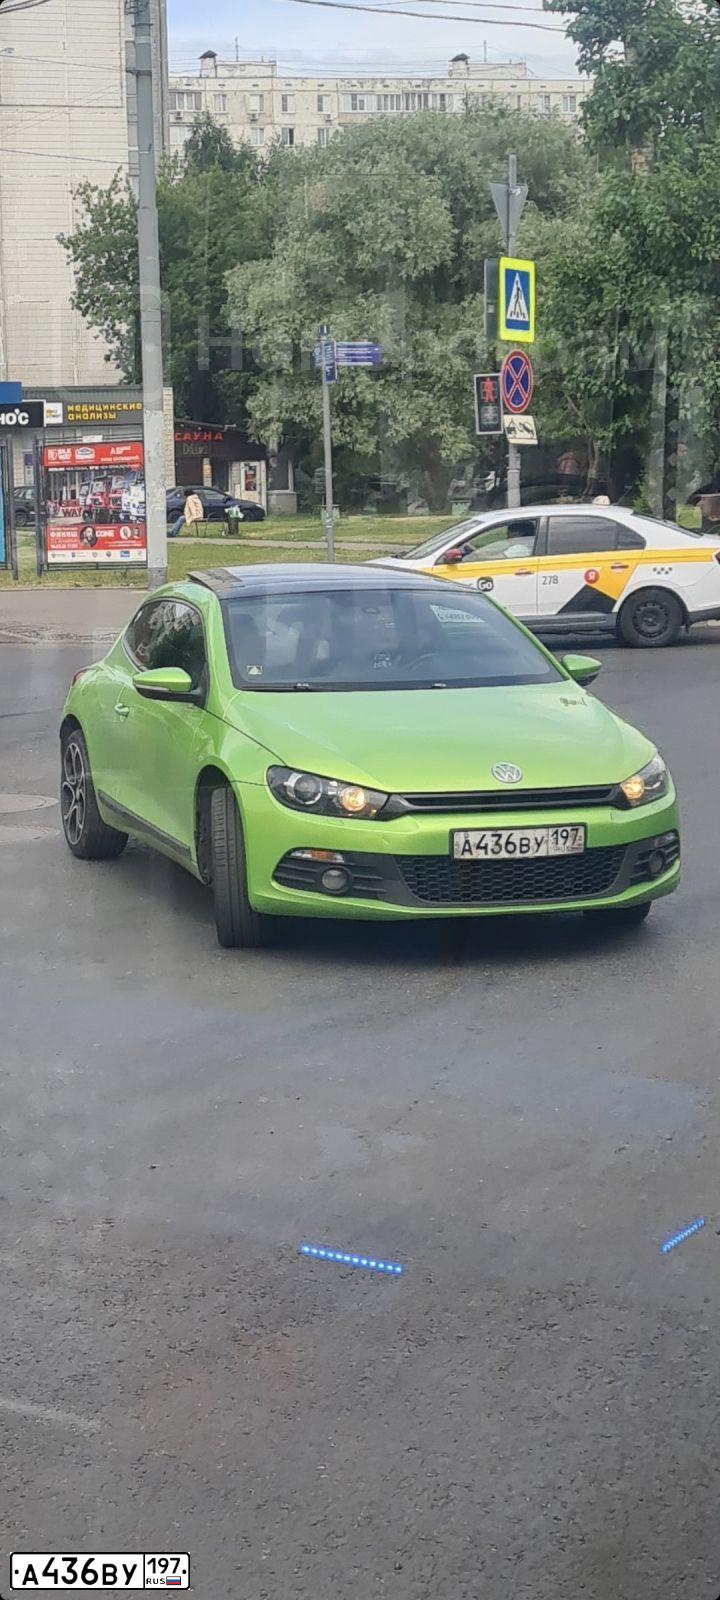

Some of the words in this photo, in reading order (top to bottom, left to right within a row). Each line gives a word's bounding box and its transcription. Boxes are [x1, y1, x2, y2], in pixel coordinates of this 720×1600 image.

[67, 402, 143, 412] медицинские
[67, 412, 117, 421] анализы
[174, 431, 224, 441] САУНА
[542, 575, 559, 585] 278
[461, 832, 545, 856] А436ВУ
[551, 828, 579, 846] 197
